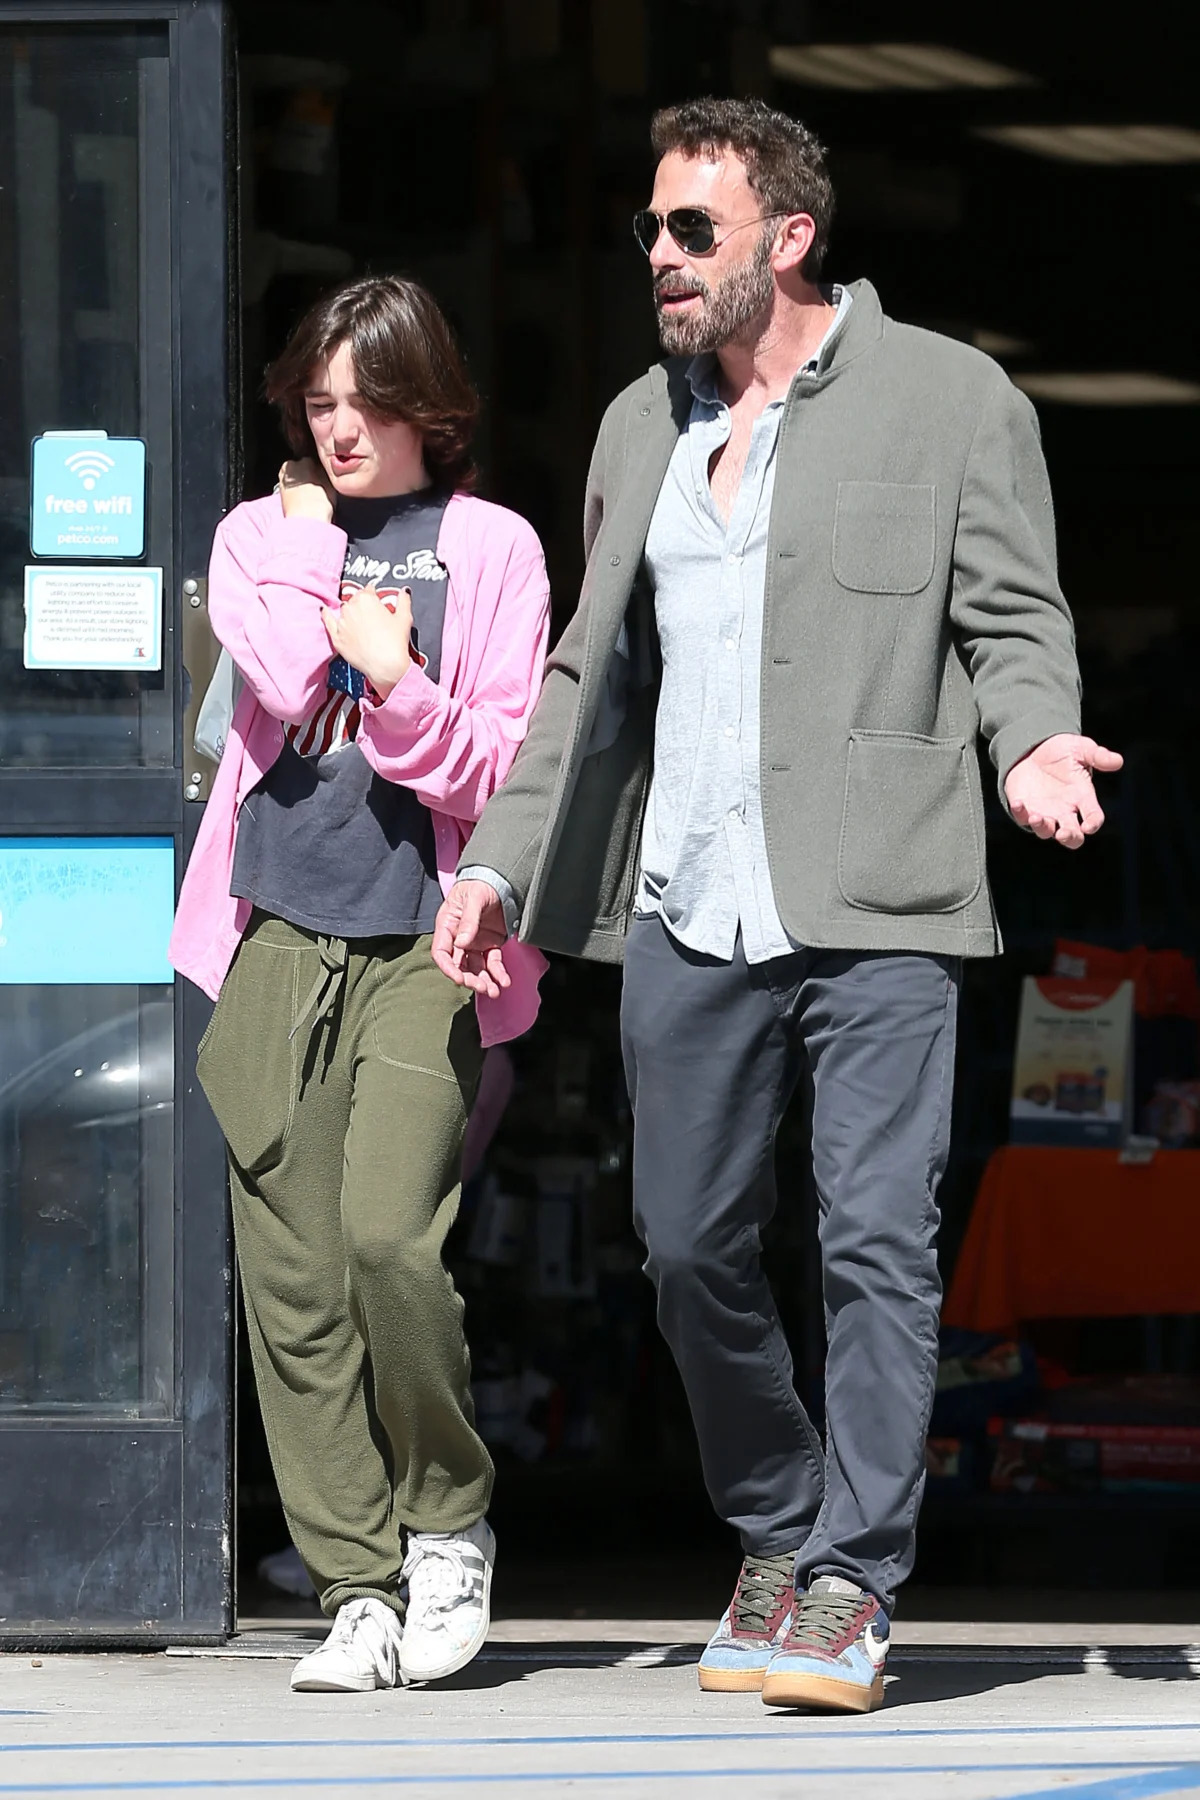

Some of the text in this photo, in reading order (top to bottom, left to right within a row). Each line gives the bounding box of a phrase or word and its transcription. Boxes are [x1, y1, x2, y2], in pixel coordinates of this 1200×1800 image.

[45, 494, 132, 515] free wifi
[57, 534, 119, 545] petco.com
